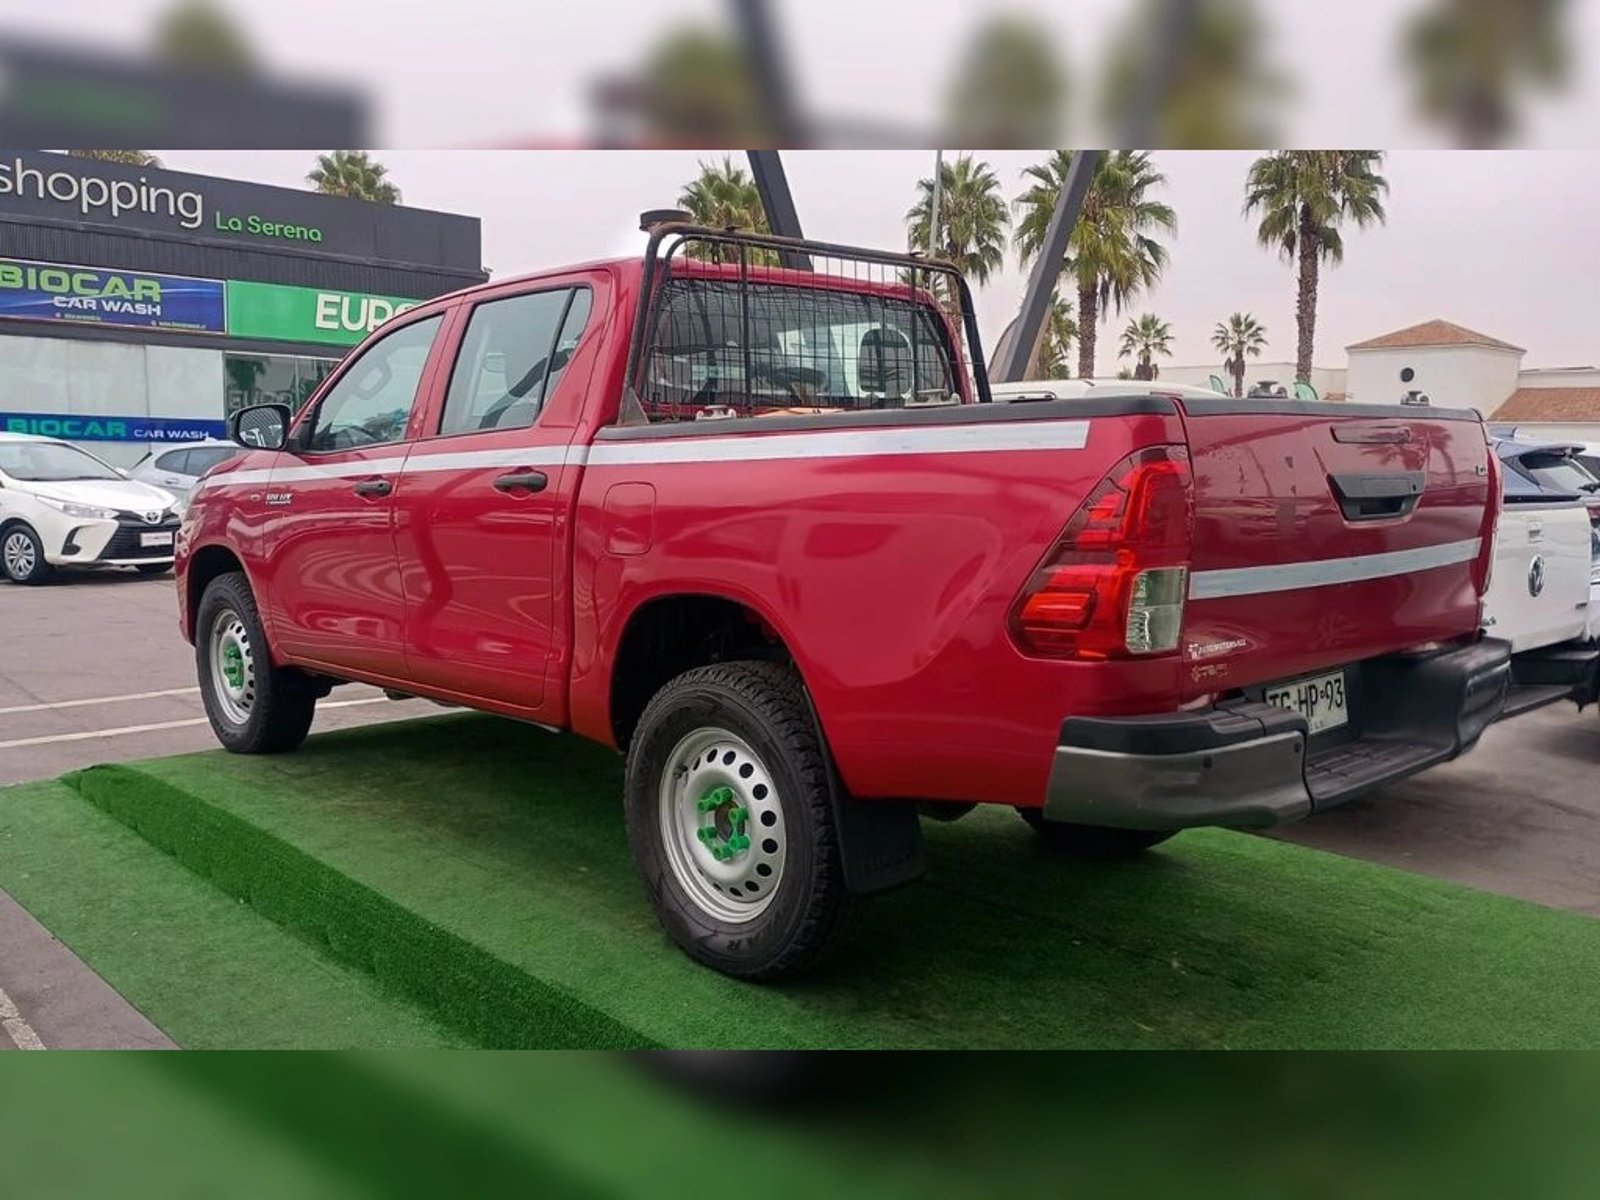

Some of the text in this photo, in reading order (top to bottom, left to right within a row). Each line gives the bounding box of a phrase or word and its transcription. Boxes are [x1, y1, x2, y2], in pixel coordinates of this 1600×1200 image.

[0, 158, 322, 242] shopping La Serena
[0, 265, 161, 302] BIOCAR
[53, 296, 161, 316] CAR WASH
[315, 293, 416, 332] EUR
[7, 418, 210, 439] BIOCAR CAR WASH
